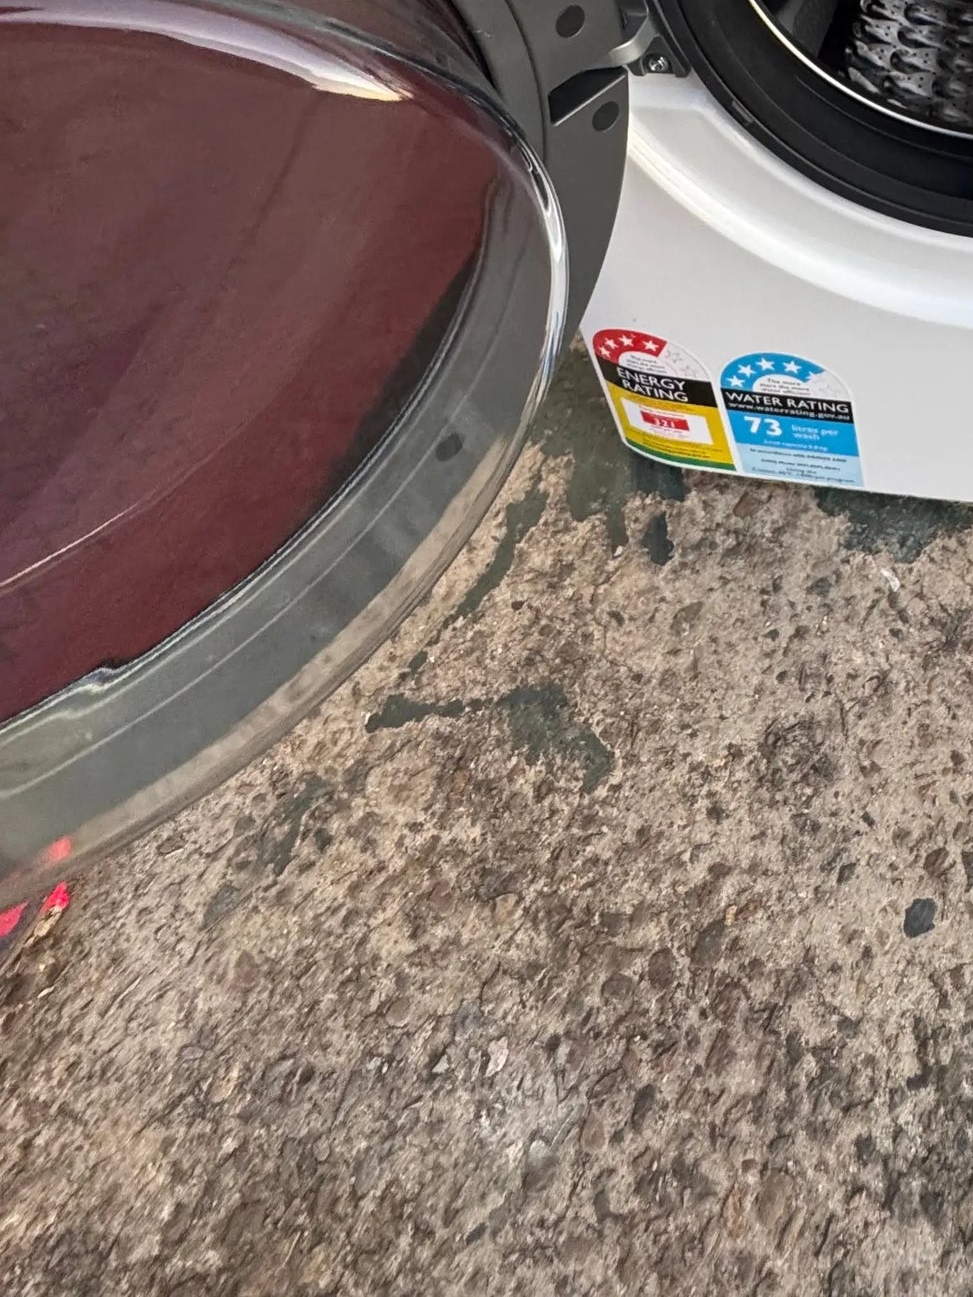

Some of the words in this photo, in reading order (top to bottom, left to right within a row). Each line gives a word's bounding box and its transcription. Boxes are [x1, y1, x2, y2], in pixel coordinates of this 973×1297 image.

[616, 366, 686, 391] ENERGY
[621, 378, 690, 403] RATING
[725, 391, 782, 407] WATER
[787, 399, 849, 413] RATING
[728, 402, 851, 421] www.waterrating.gov.au
[743, 415, 783, 437] 73
